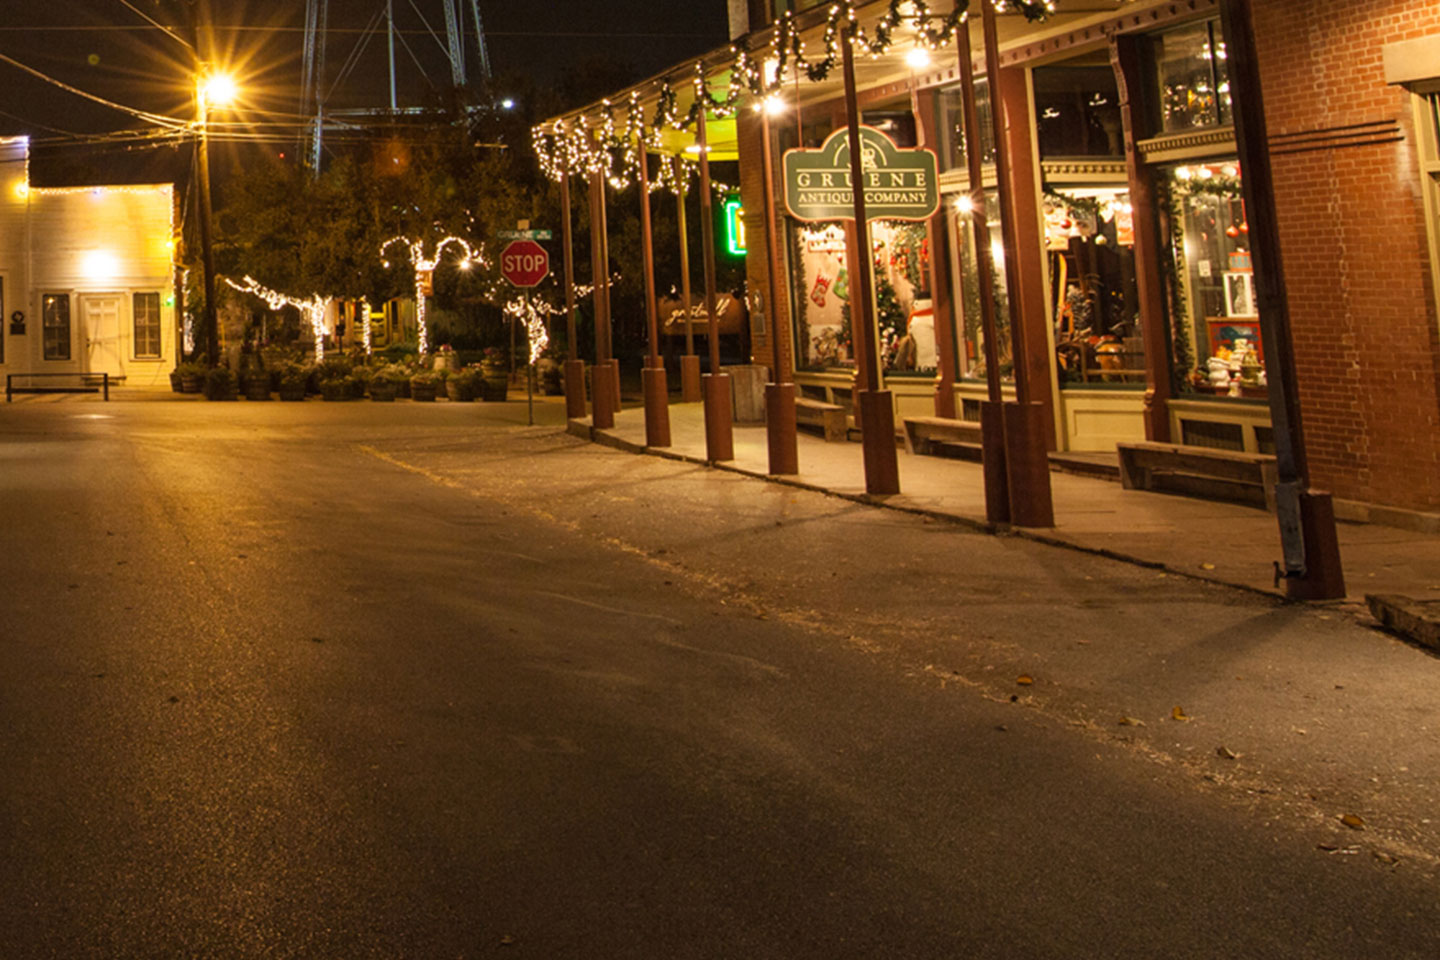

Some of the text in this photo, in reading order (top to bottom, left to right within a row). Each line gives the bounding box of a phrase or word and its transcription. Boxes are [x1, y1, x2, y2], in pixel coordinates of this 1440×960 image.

[797, 172, 927, 187] GRUENE
[798, 192, 928, 204] ANTIQU COMPANY
[504, 254, 545, 273] STOP
